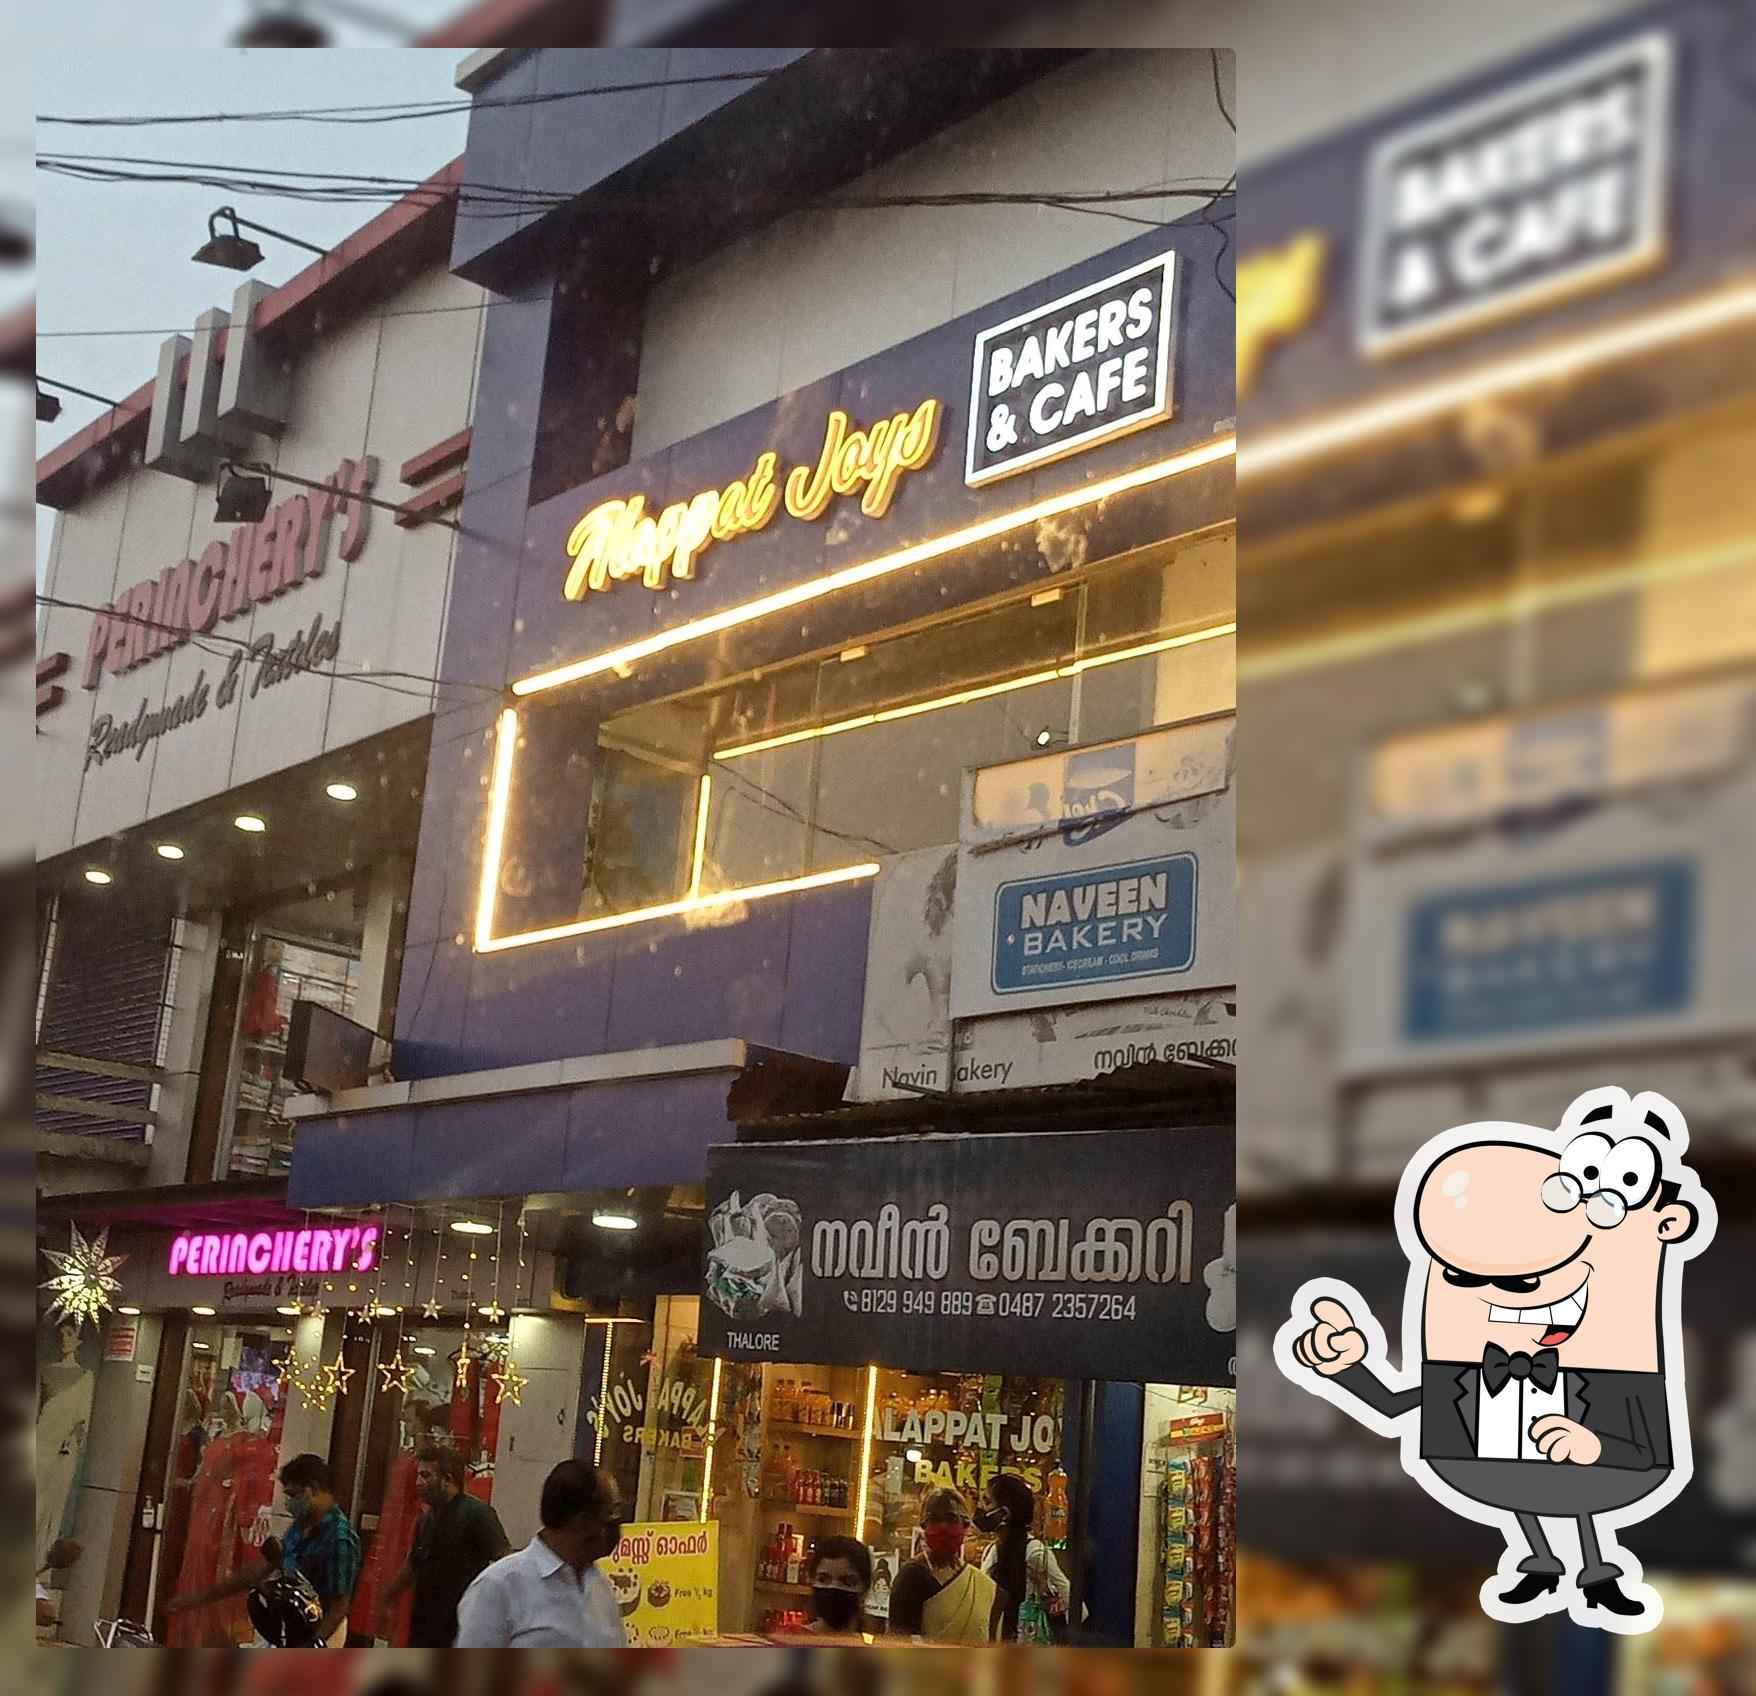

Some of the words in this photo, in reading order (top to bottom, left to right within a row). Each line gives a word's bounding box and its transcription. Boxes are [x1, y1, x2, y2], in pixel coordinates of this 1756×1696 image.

[989, 287, 1153, 397] BAKERS
[986, 404, 1018, 452] &
[1029, 346, 1149, 435] CAFE
[784, 398, 942, 519] Joys
[1020, 872, 1168, 930] NAVEEN
[1023, 913, 1168, 956] BAKERY
[882, 1063, 938, 1089] Navin
[953, 1057, 1013, 1084] akery
[168, 1226, 379, 1275] PERINCHERY'S
[811, 1203, 950, 1280] നവീൻ
[969, 1200, 1194, 1284] ബേക്കറി
[861, 1289, 897, 1313] 8129
[902, 1290, 935, 1314] 949
[940, 1291, 973, 1316] 889
[999, 1292, 1045, 1317] 0487
[1052, 1294, 1137, 1321] 2357264
[726, 1331, 780, 1351] THALORE
